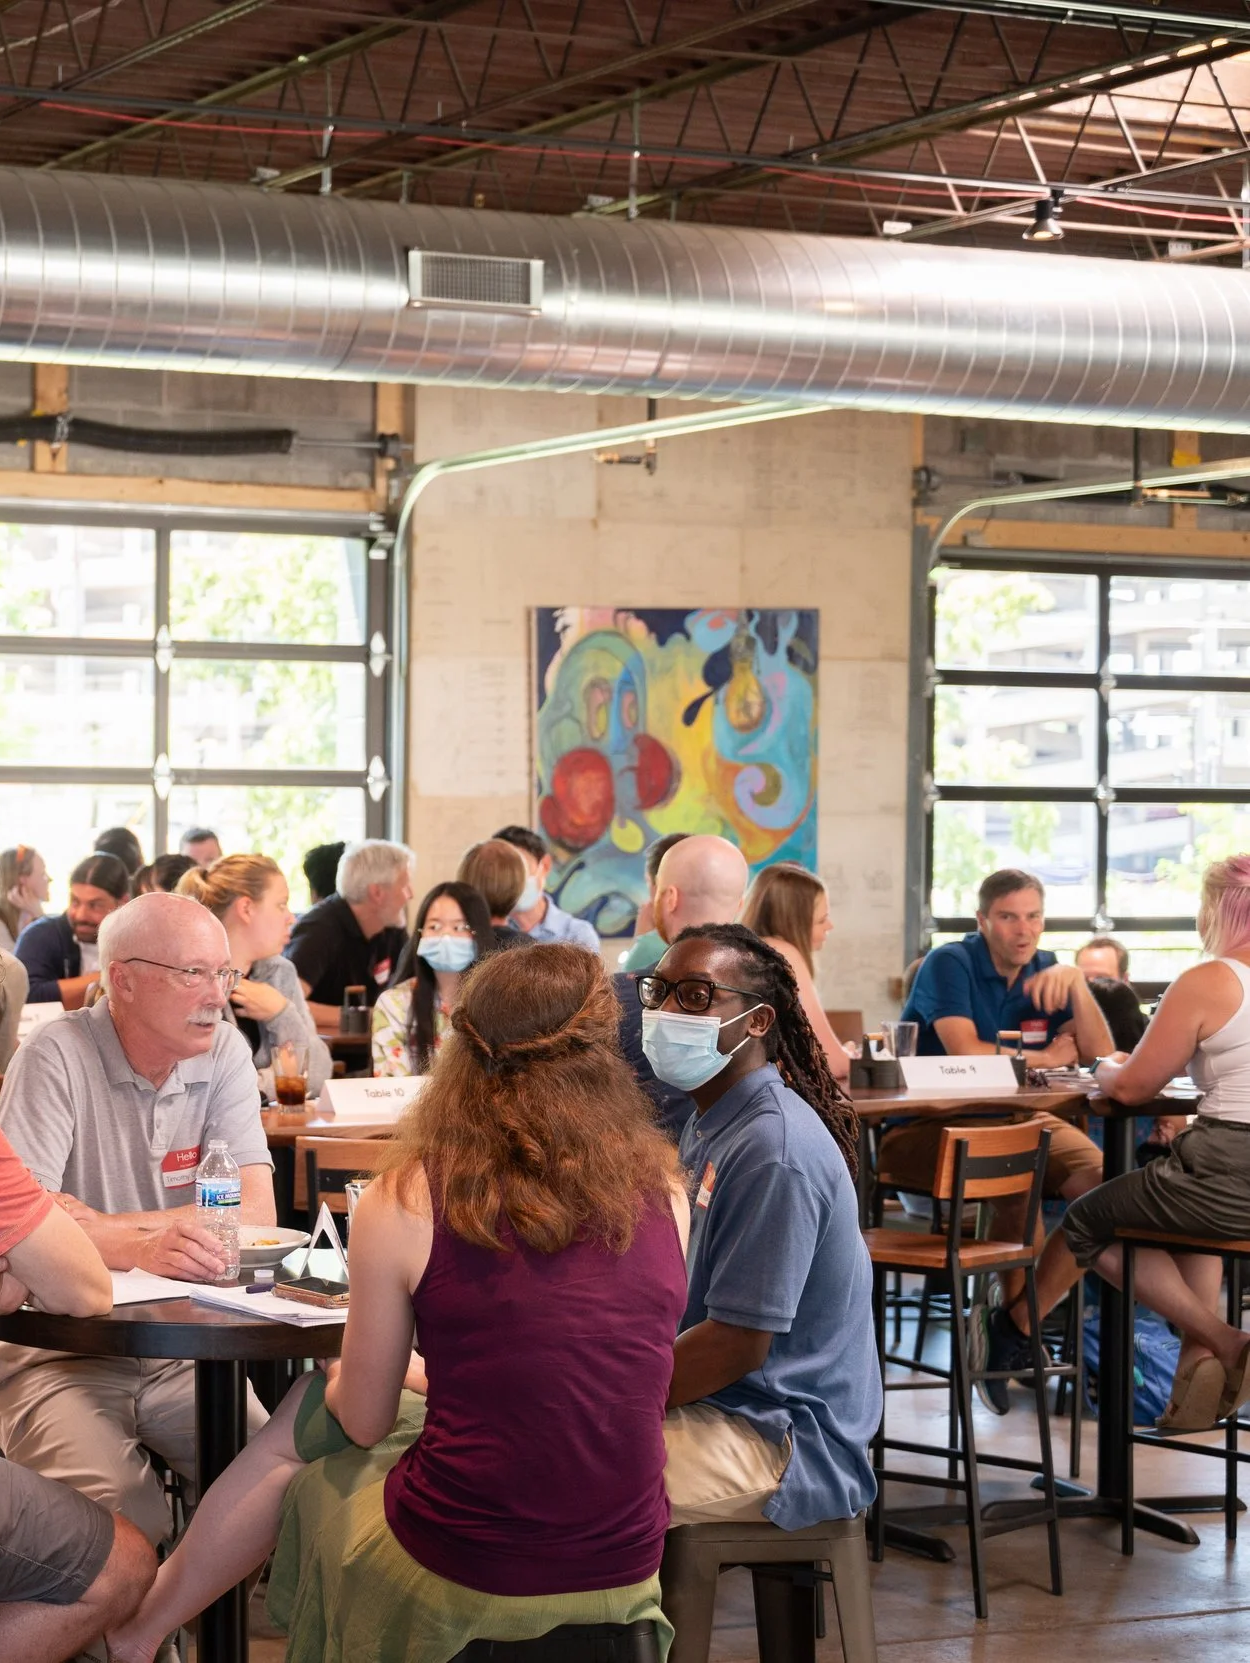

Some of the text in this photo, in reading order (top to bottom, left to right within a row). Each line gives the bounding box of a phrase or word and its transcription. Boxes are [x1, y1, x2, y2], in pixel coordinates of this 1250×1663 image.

[939, 1064, 977, 1074] Table 9
[363, 1087, 405, 1098] Table 10
[176, 1151, 198, 1162] Hello
